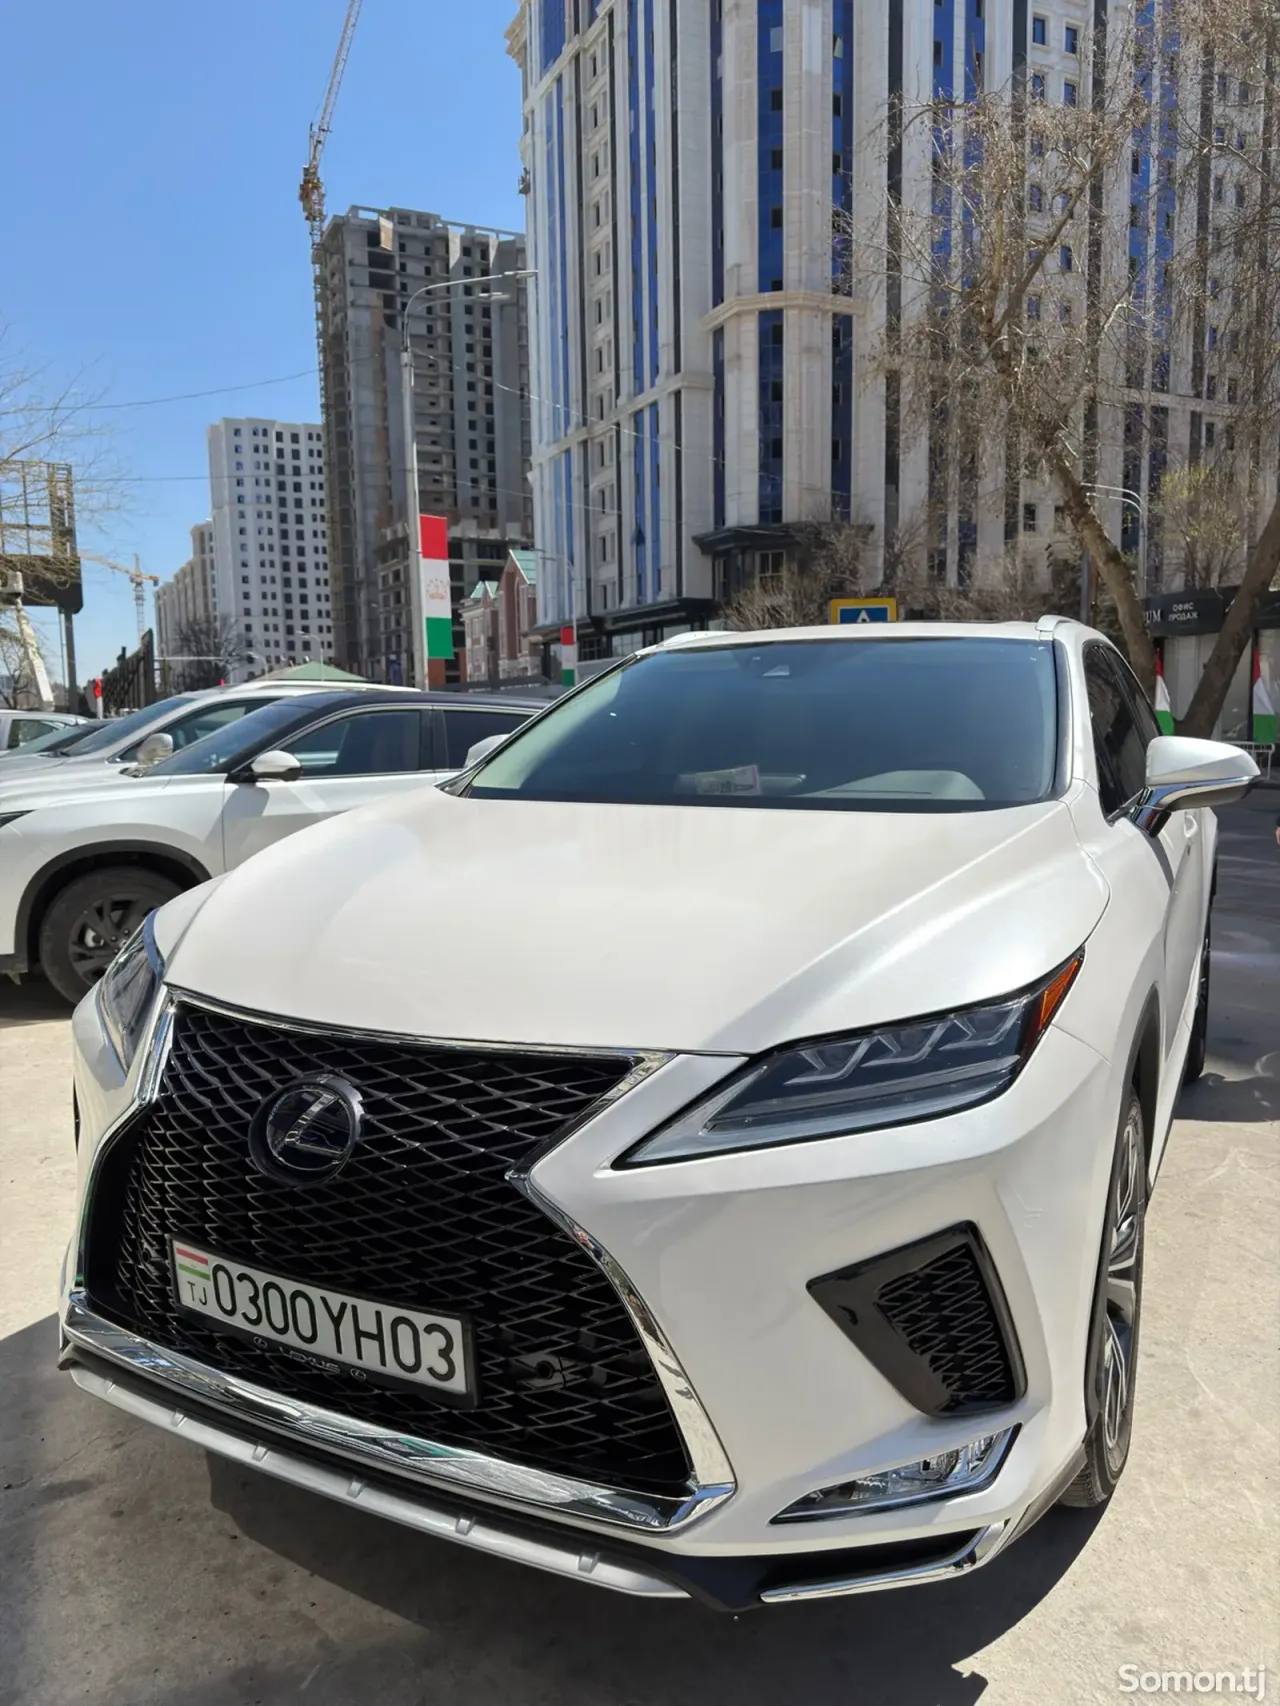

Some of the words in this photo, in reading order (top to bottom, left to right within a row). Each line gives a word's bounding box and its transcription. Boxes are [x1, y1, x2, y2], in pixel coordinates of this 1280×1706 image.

[1172, 602, 1194, 612] ОФИС
[1168, 611, 1198, 621] ПРОДАЖ
[187, 1281, 207, 1306] TJ
[211, 1263, 456, 1382] 0300YH03
